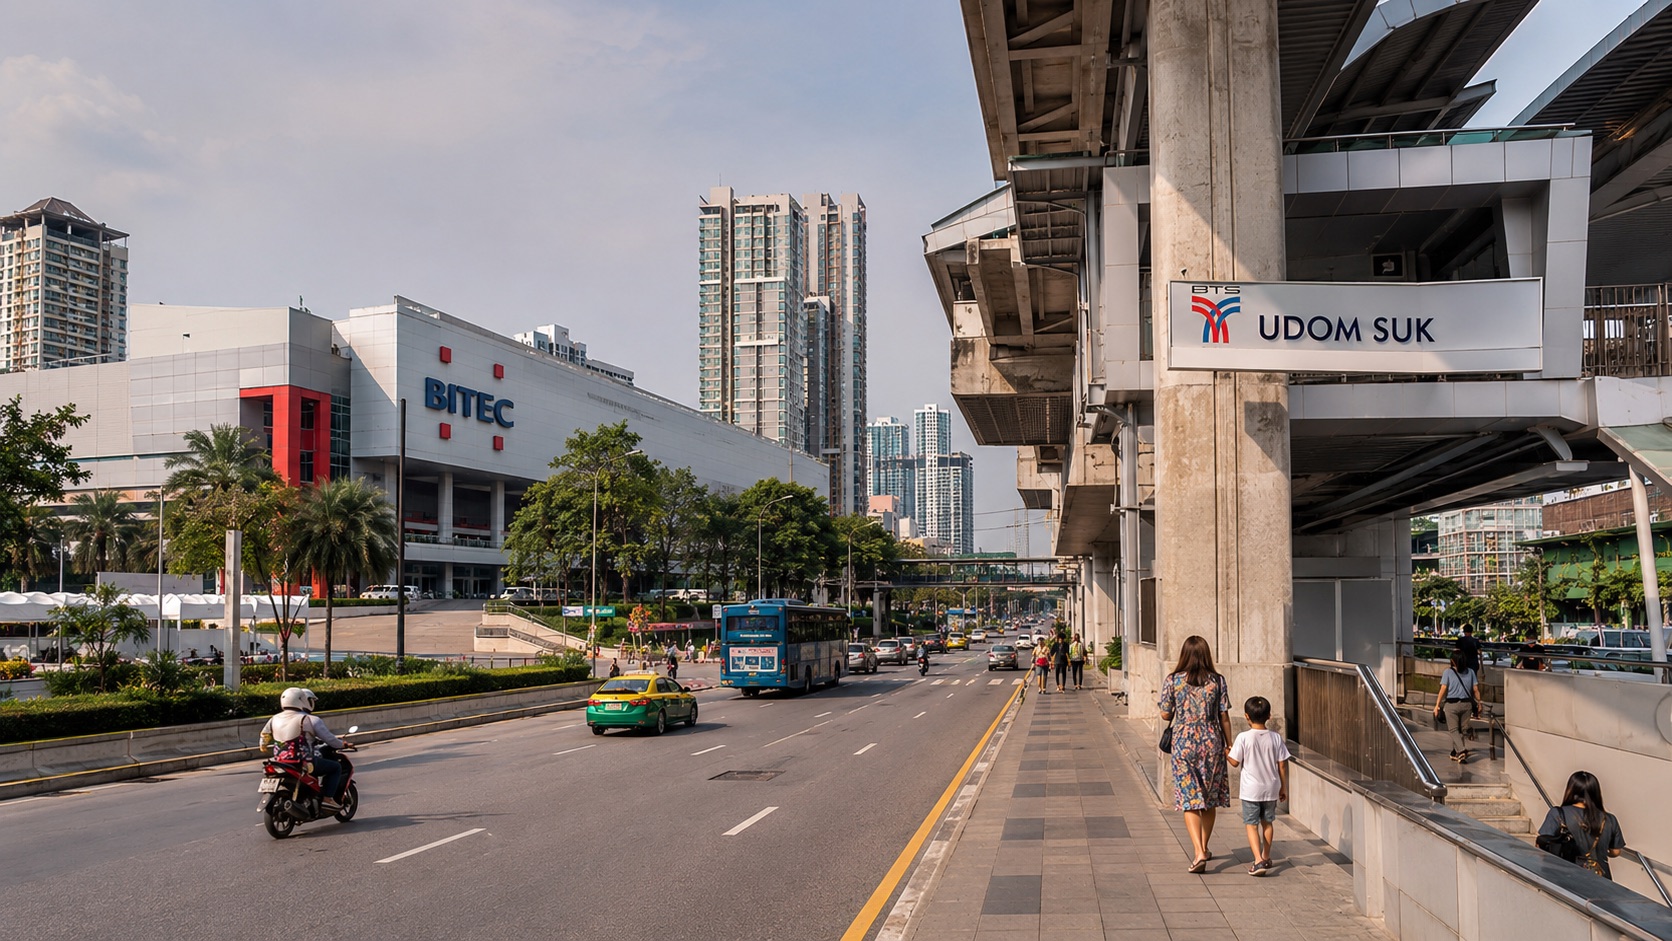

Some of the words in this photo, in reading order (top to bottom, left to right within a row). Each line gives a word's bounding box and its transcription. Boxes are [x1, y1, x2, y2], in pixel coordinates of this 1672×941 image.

[1191, 285, 1241, 294] BTS
[1259, 315, 1362, 342] UDOM
[1373, 317, 1435, 342] SUK
[425, 377, 514, 428] BITEC
